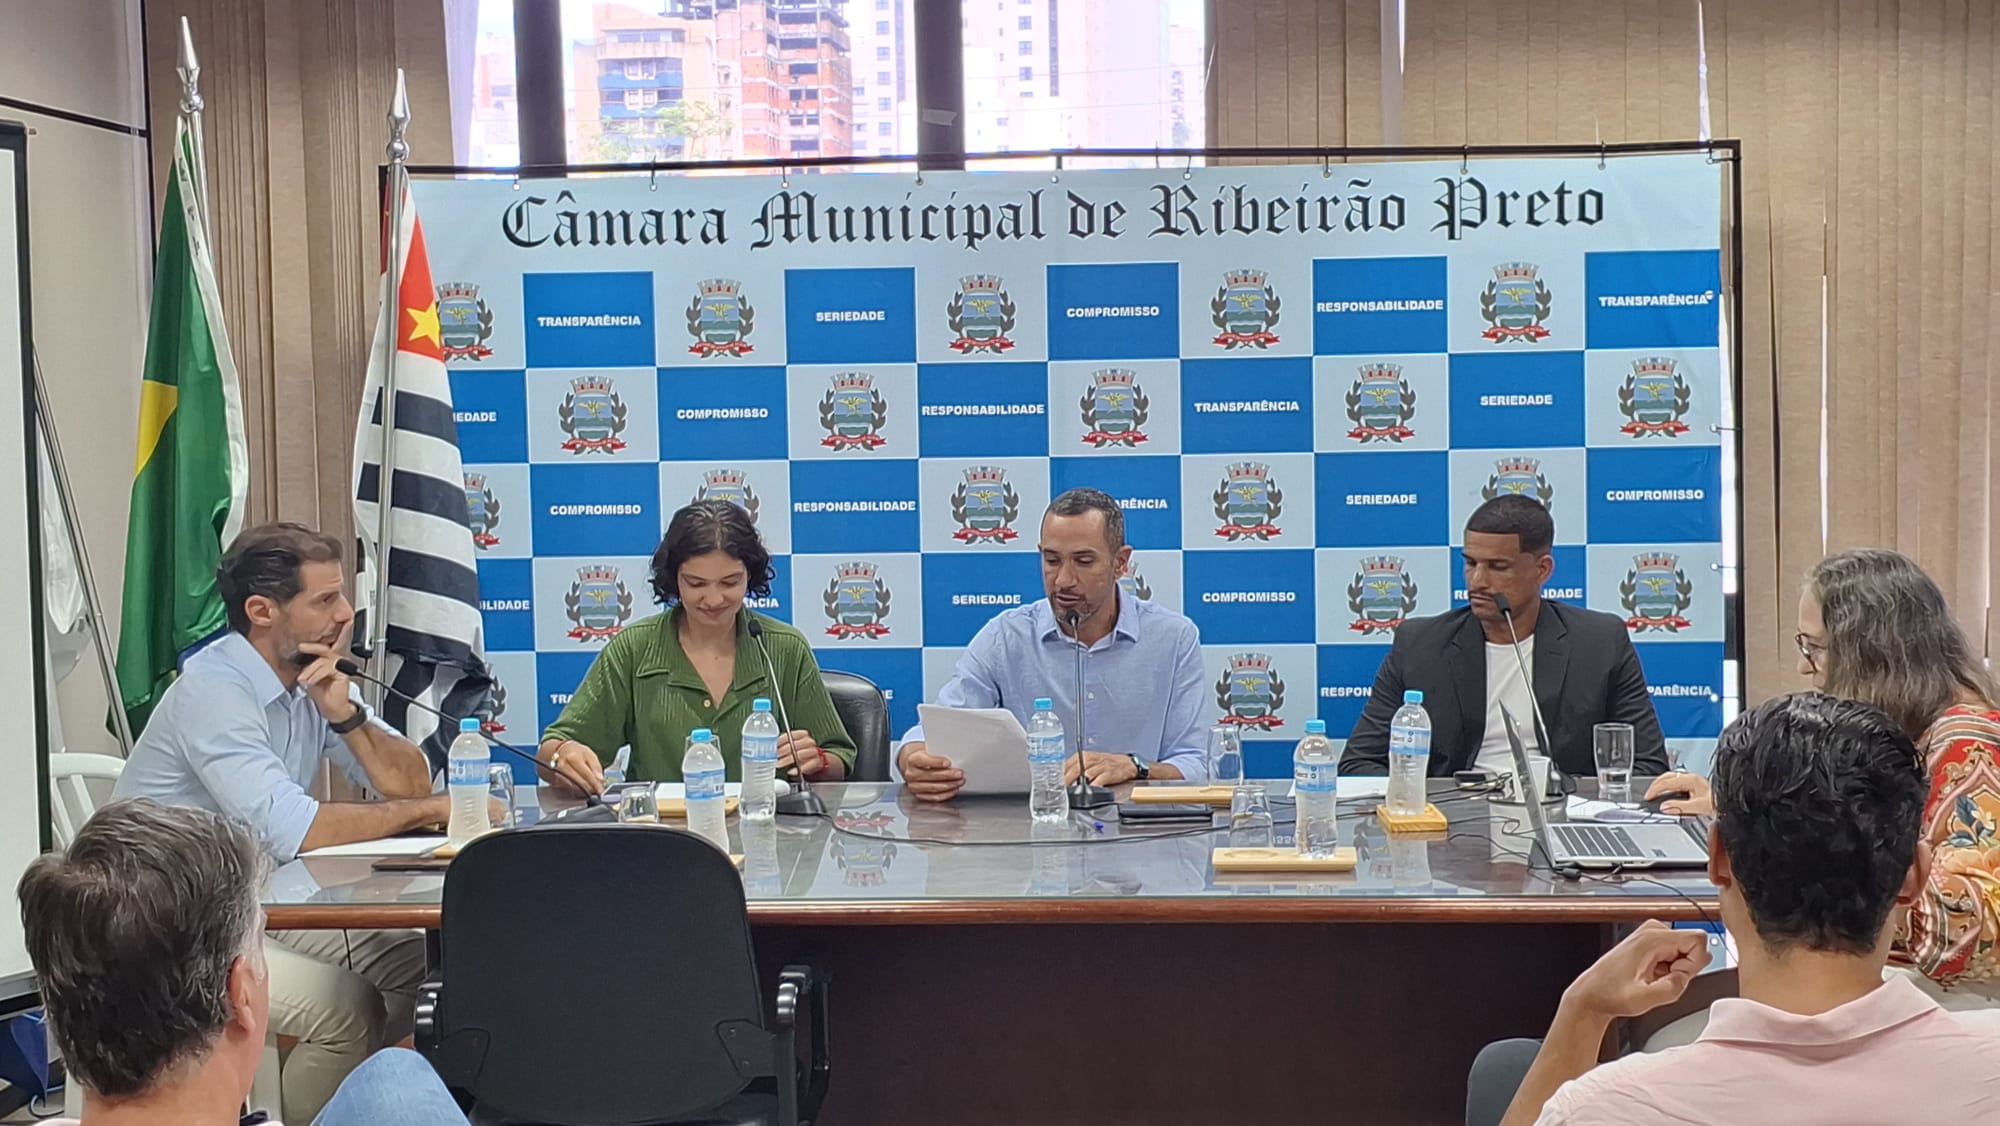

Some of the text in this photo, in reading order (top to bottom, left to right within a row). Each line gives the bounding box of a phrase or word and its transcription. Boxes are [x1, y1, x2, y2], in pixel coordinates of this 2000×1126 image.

[503, 178, 1602, 250] Câmara Municipal de Ribeirão Preto
[1316, 299, 1444, 313] RESPONSABILIDADE
[1599, 293, 1708, 307] TRANSPARÊNCIA
[816, 310, 886, 322] SERIEDADE
[1066, 306, 1160, 318] COMPROMISSO
[537, 314, 641, 327] TRANSPARÊNCIA
[1194, 399, 1300, 413] TRANSPARÊNCIA
[1480, 394, 1553, 406] SERIEDADE
[676, 408, 769, 420] COMPROMISSO
[921, 404, 1045, 416] RESPONSABILIDADE
[452, 411, 497, 422] IEDADE
[1345, 494, 1417, 505] SERIEDADE
[1606, 489, 1704, 501] COMPROMISSO
[549, 504, 642, 516] COMPROMISSO
[793, 500, 917, 513] RESPONSABILIDADE
[952, 594, 1022, 606] SERIEDADE
[1202, 591, 1296, 603] COMPROMISSO
[1646, 684, 1712, 696] PARÊNCIA
